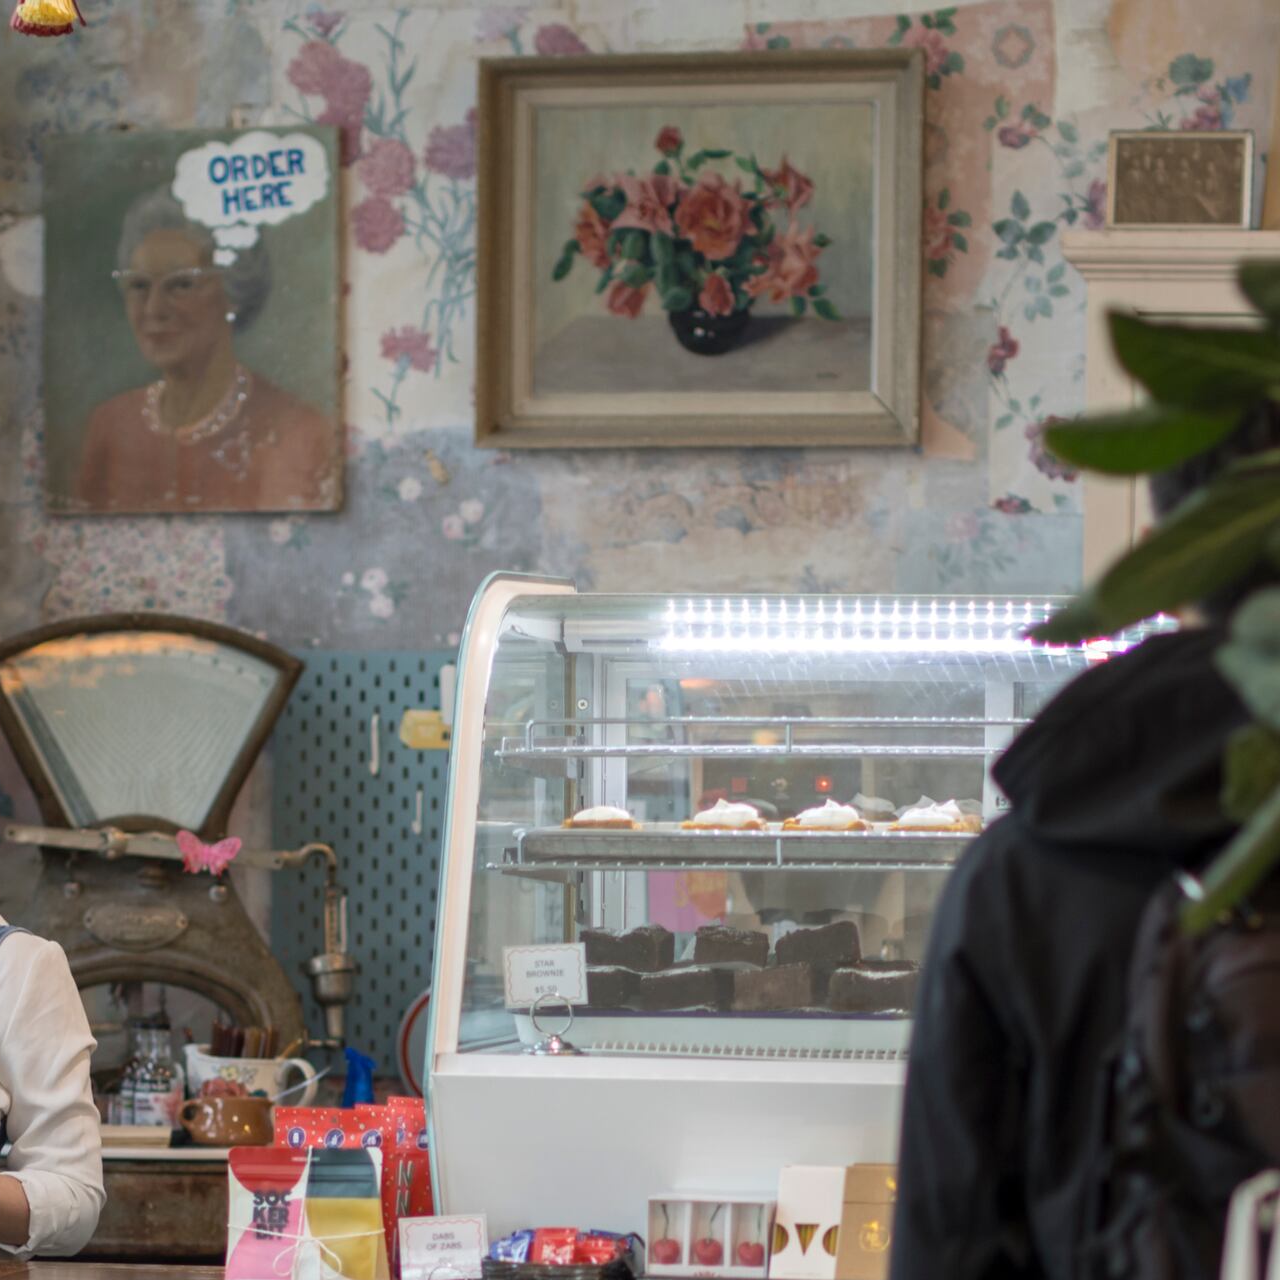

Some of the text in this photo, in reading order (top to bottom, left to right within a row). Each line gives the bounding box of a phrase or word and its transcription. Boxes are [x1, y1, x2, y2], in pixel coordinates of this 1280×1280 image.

[208, 148, 306, 185] ORDER
[222, 181, 294, 215] HERE
[534, 959, 555, 968] STAR
[525, 969, 565, 978] BROWNIE
[534, 984, 558, 994] $5.50
